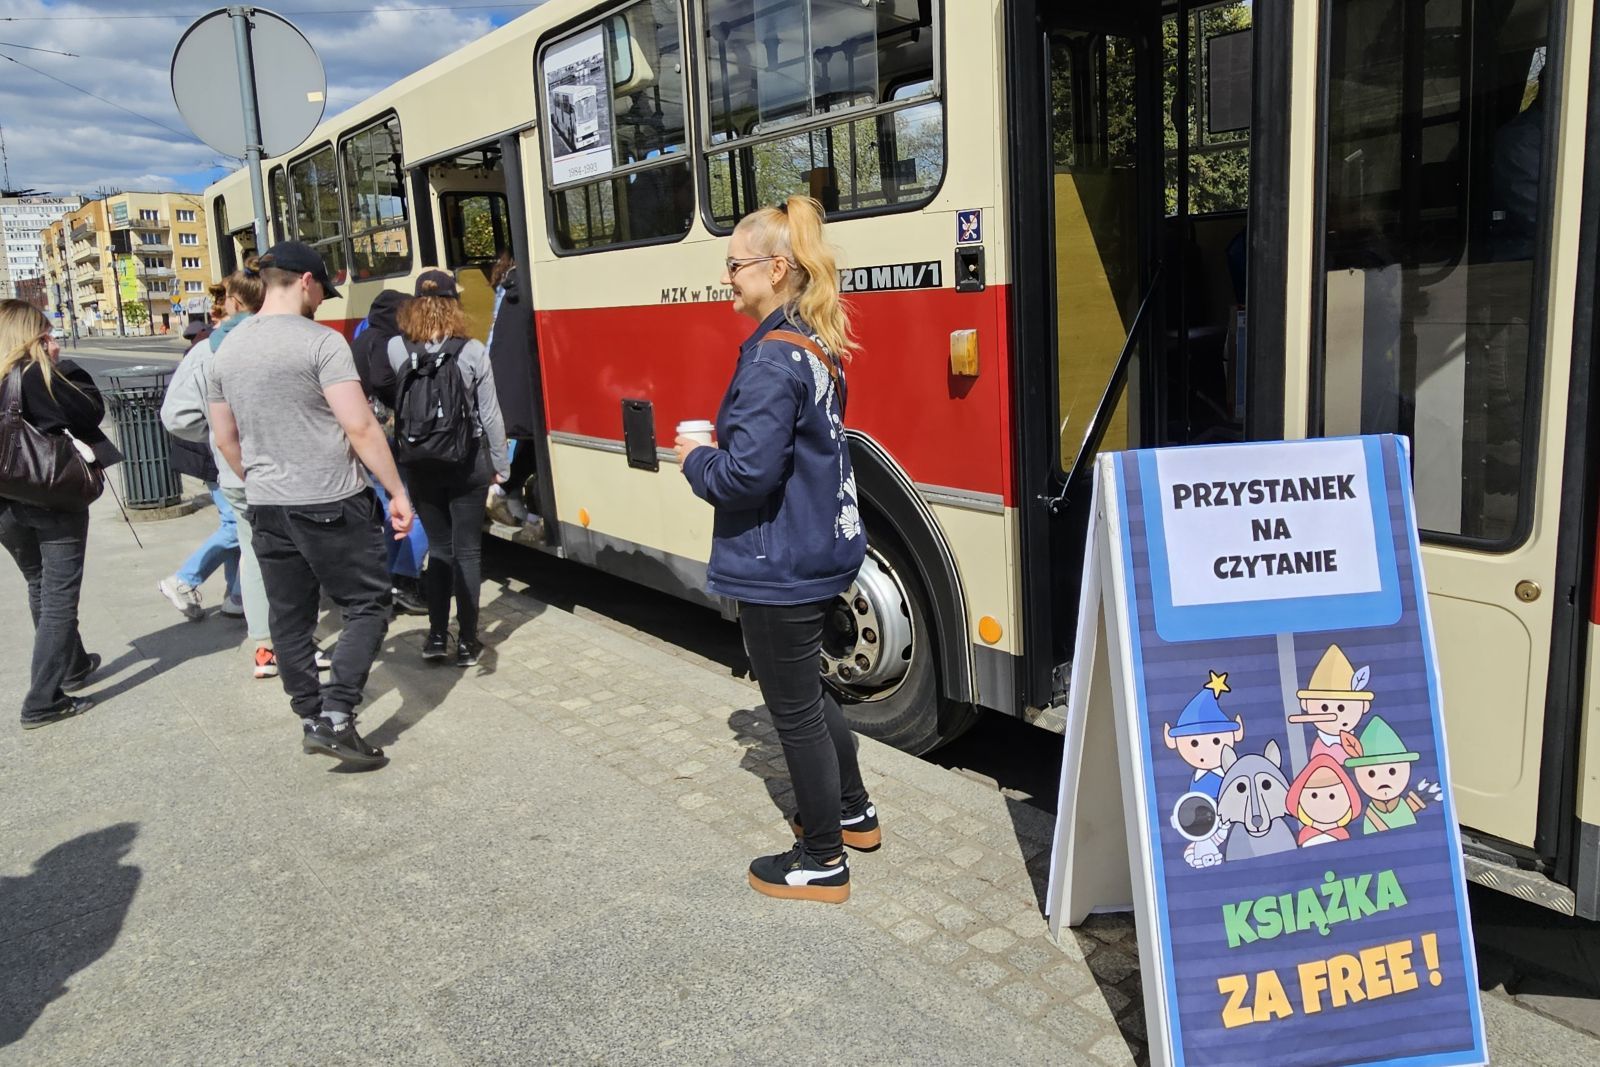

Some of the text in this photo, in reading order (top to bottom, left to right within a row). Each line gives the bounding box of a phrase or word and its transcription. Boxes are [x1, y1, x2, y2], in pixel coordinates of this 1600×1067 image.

[661, 285, 735, 303] MZK w Toru
[1172, 474, 1357, 510] PRZYSTANEK
[1251, 518, 1292, 541] NA
[1213, 549, 1338, 579] CZYTANIE
[1222, 869, 1408, 948] KSIĄŻKA
[1217, 970, 1294, 1029] ZA
